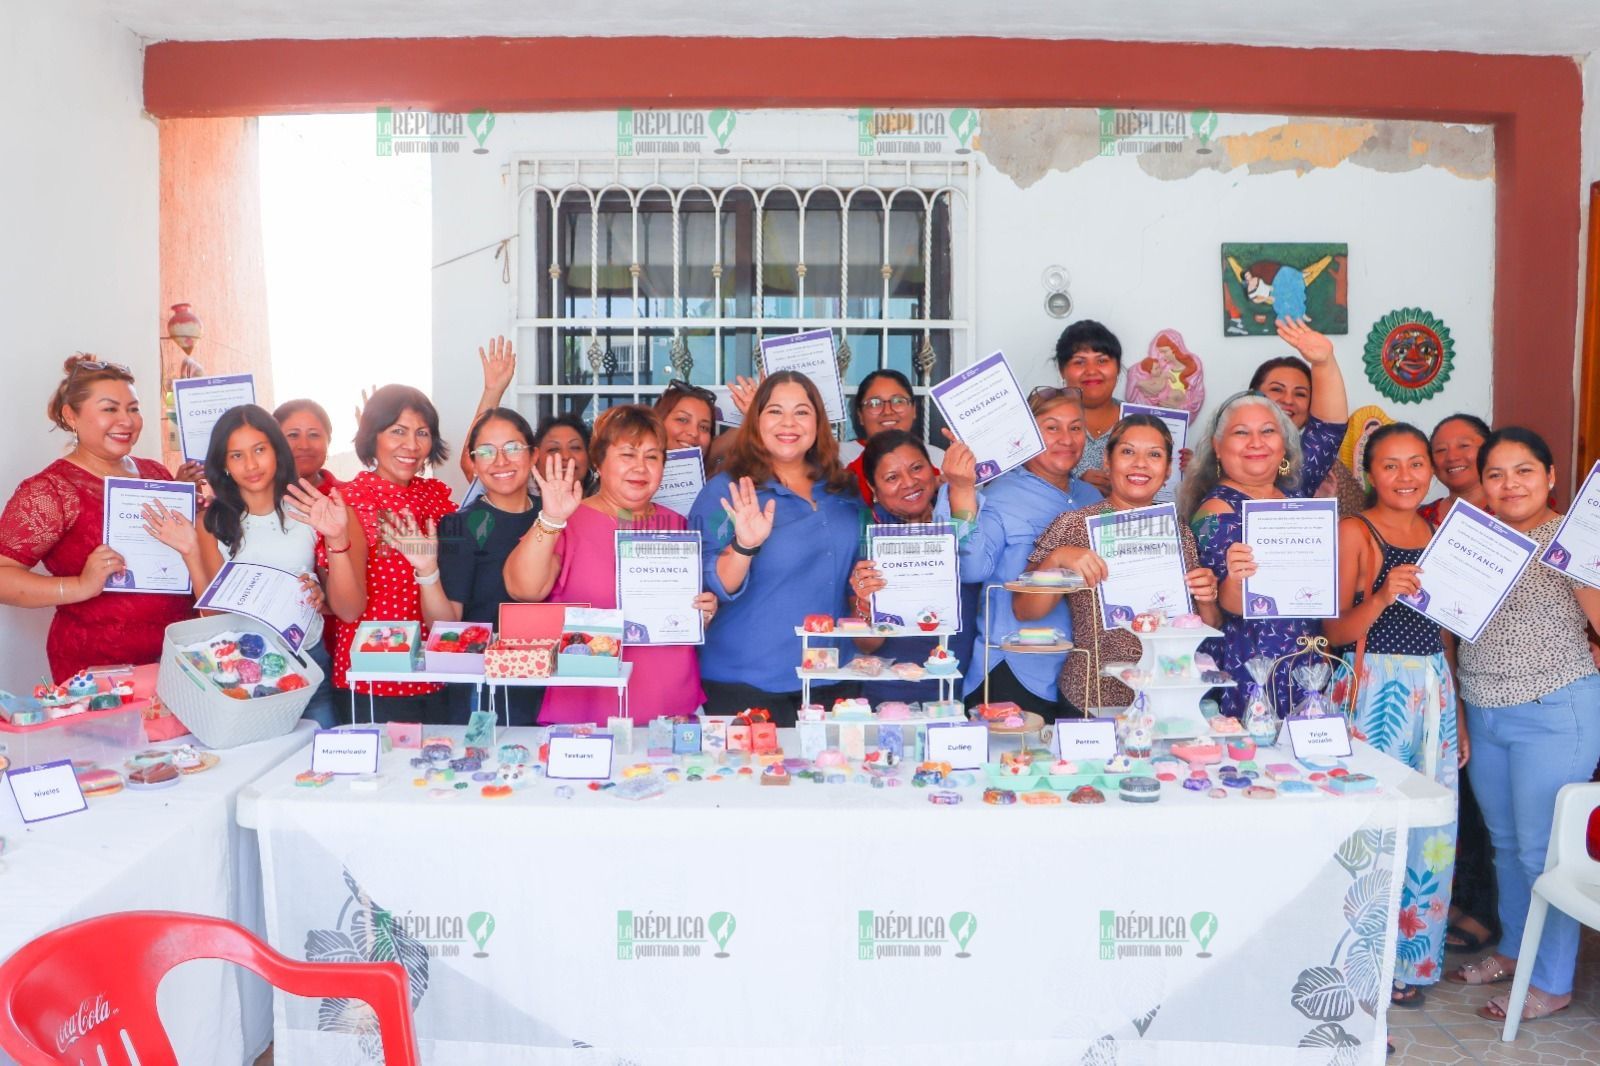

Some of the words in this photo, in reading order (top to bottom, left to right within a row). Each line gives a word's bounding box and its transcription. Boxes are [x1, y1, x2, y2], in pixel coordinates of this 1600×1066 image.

[959, 389, 1009, 421] CONSTANCIA
[1106, 542, 1168, 558] CONSTANCIA
[1448, 538, 1504, 575] CONSTANCIA
[882, 560, 945, 568] CONSTANCIA
[237, 572, 262, 606] CONSTANCIA
[33, 787, 60, 798] Niveles
